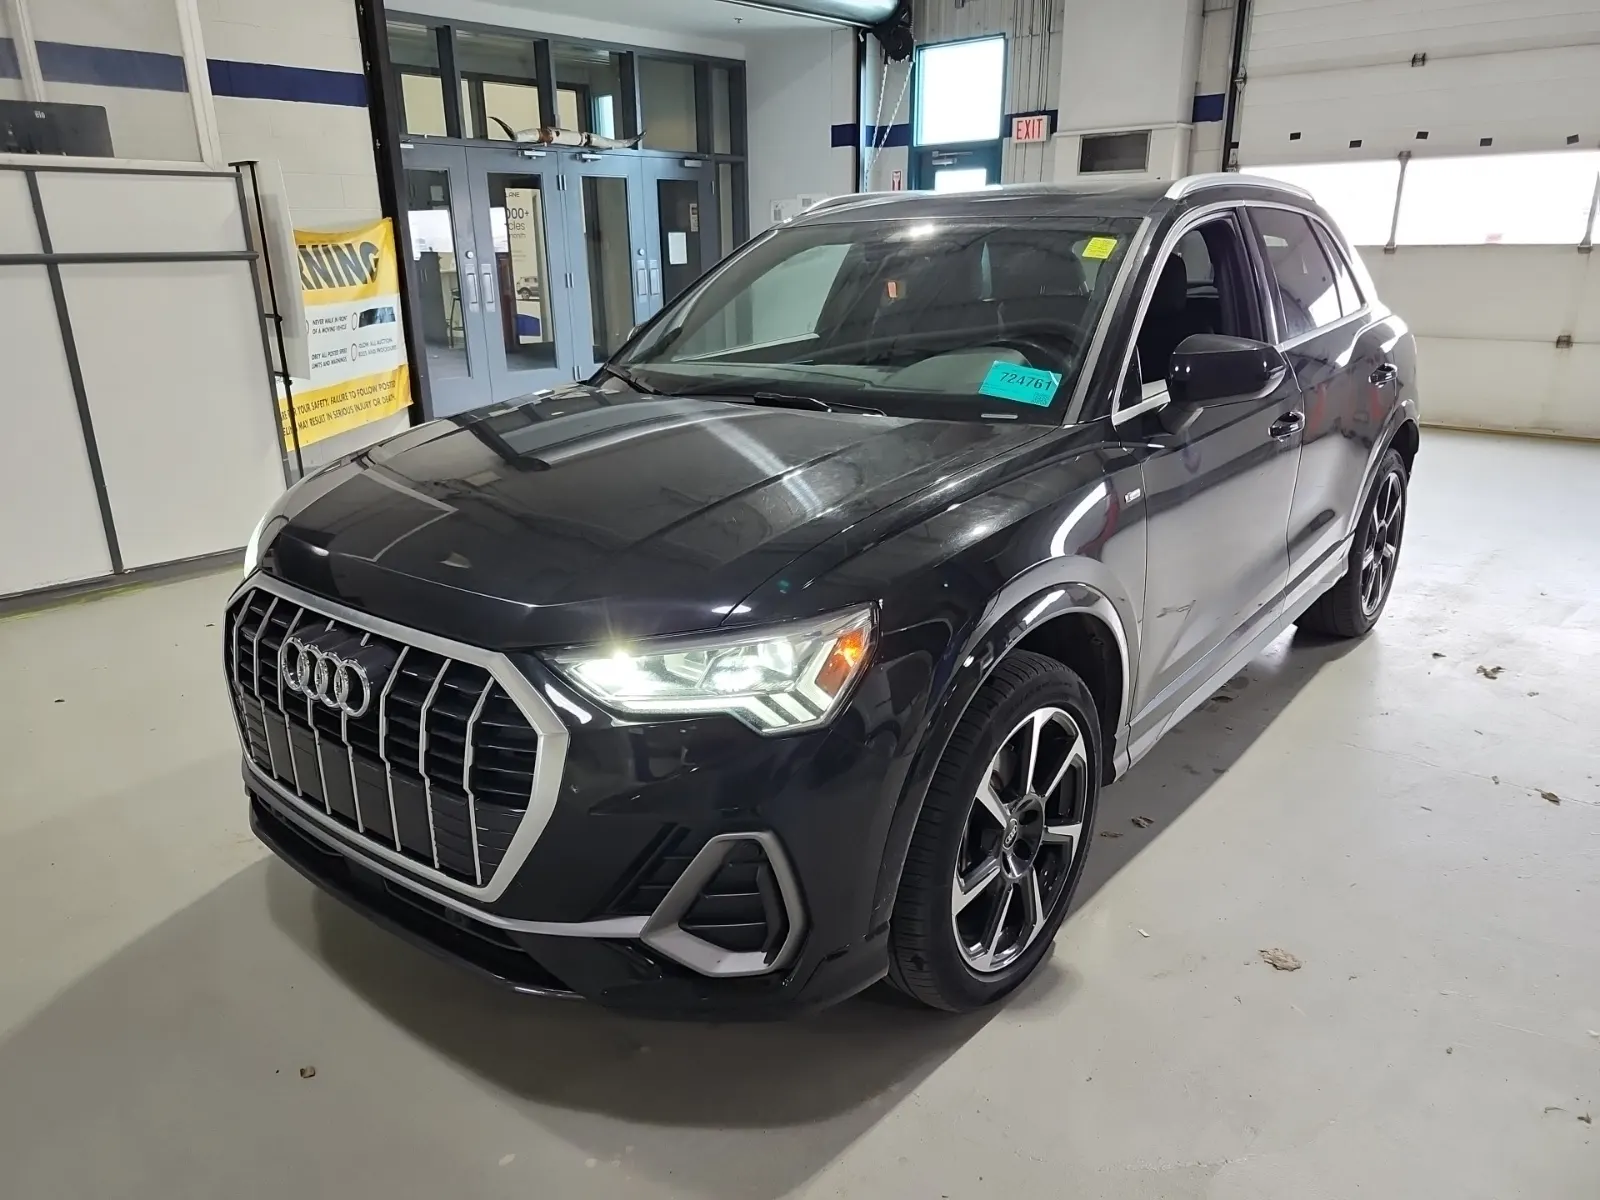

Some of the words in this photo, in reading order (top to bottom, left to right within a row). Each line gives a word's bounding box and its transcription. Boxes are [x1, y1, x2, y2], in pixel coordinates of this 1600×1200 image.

[1016, 118, 1043, 140] EXIT
[508, 220, 526, 231] cles
[1000, 371, 1053, 391] 724761
[297, 403, 311, 416] YOUR
[331, 392, 349, 405] FAILURE
[348, 390, 357, 399] TO
[357, 384, 378, 397] FOLLOW
[298, 420, 309, 431] MAY
[309, 414, 326, 427] RESULT
[326, 411, 333, 420] IN
[332, 405, 354, 419] SERIOUS
[354, 399, 372, 413] INJURY
[373, 397, 382, 407] OR
